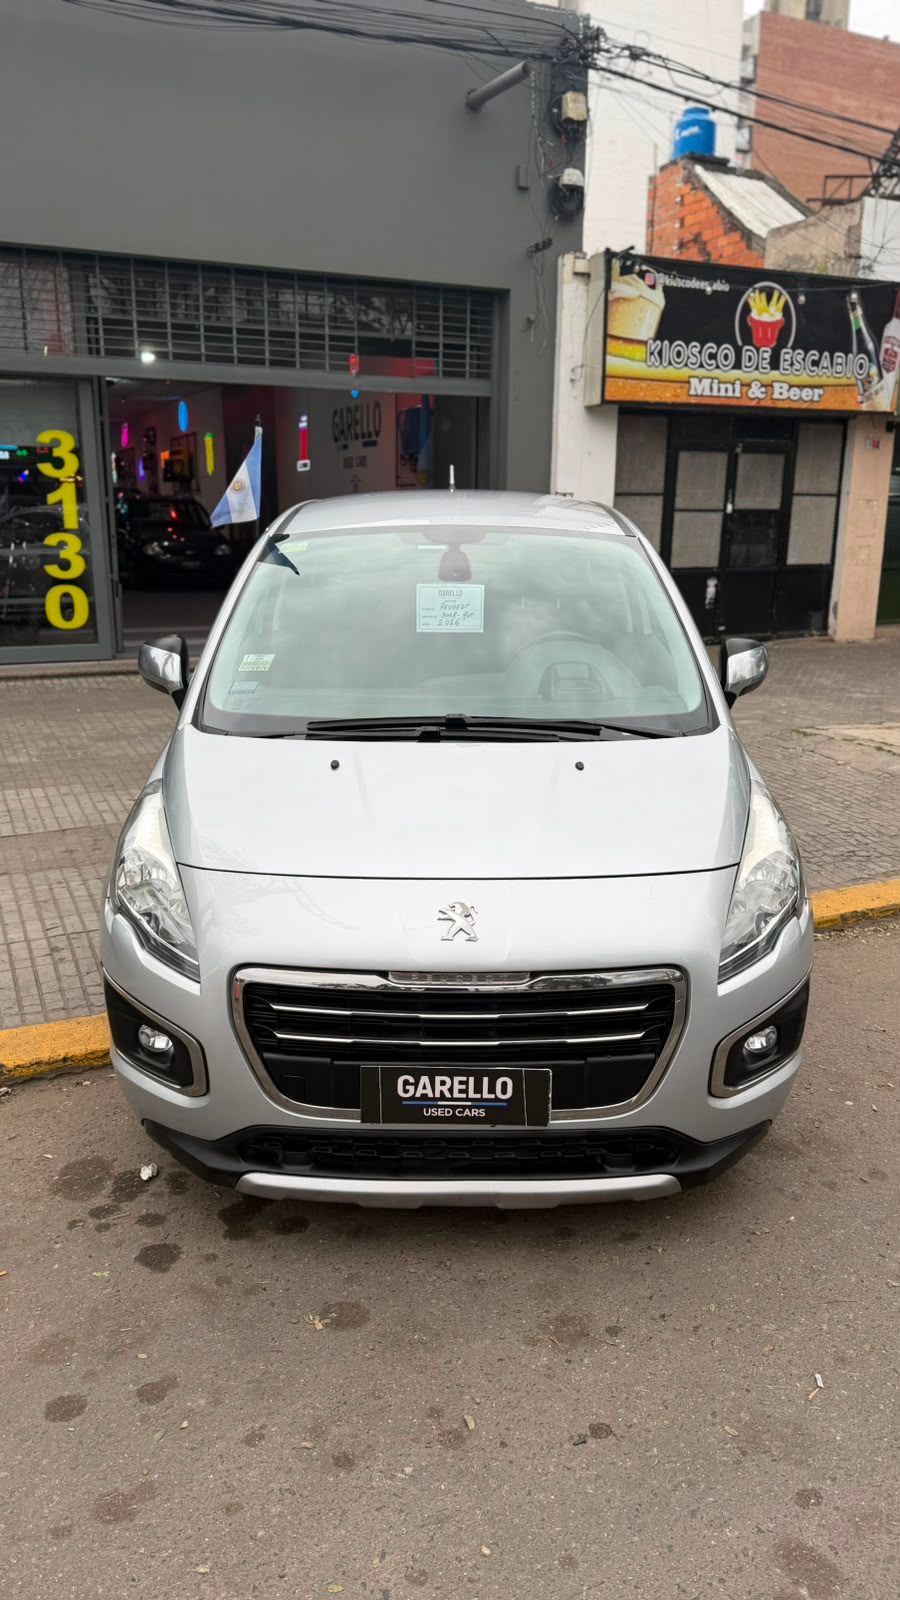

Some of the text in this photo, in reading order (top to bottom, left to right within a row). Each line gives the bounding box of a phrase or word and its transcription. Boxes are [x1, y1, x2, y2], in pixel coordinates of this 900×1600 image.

[646, 339, 735, 372] KIOSCO
[742, 346, 773, 373] DE
[780, 348, 870, 380] ESCABIO
[688, 376, 824, 402] Mini & Beer
[331, 400, 382, 443] GARELLO
[36, 429, 90, 630] 3130
[396, 1074, 514, 1100] GARELLO
[423, 1107, 486, 1118] USED CARS
